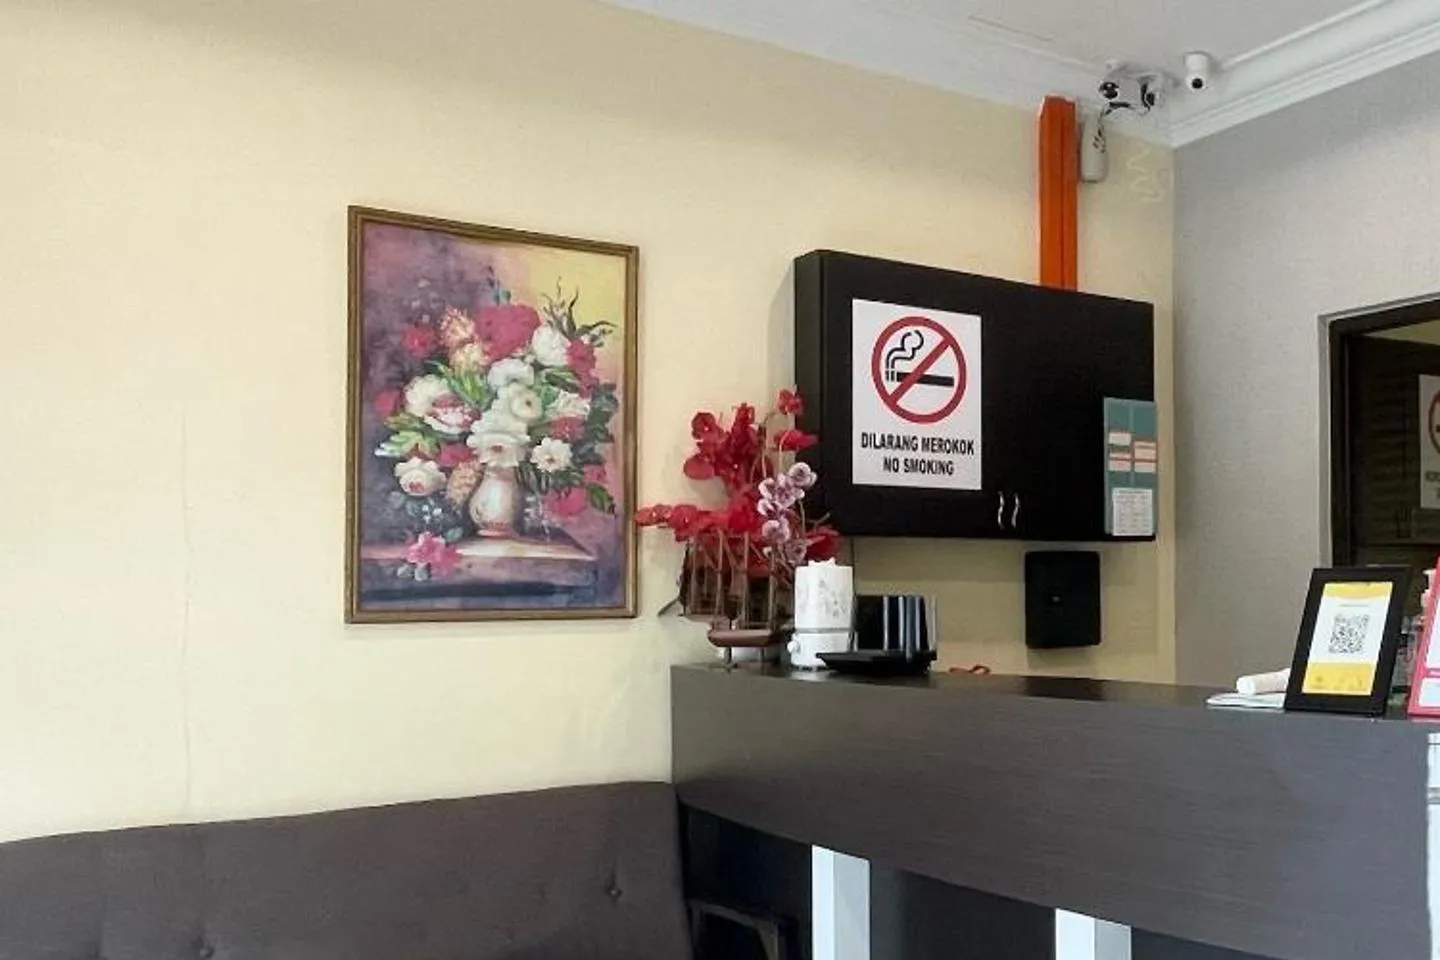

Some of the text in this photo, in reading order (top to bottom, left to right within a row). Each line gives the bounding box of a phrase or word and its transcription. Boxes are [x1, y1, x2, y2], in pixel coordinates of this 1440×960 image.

[861, 432, 975, 456] DILARANG MEROKOK
[883, 457, 954, 476] NO SMOKING
